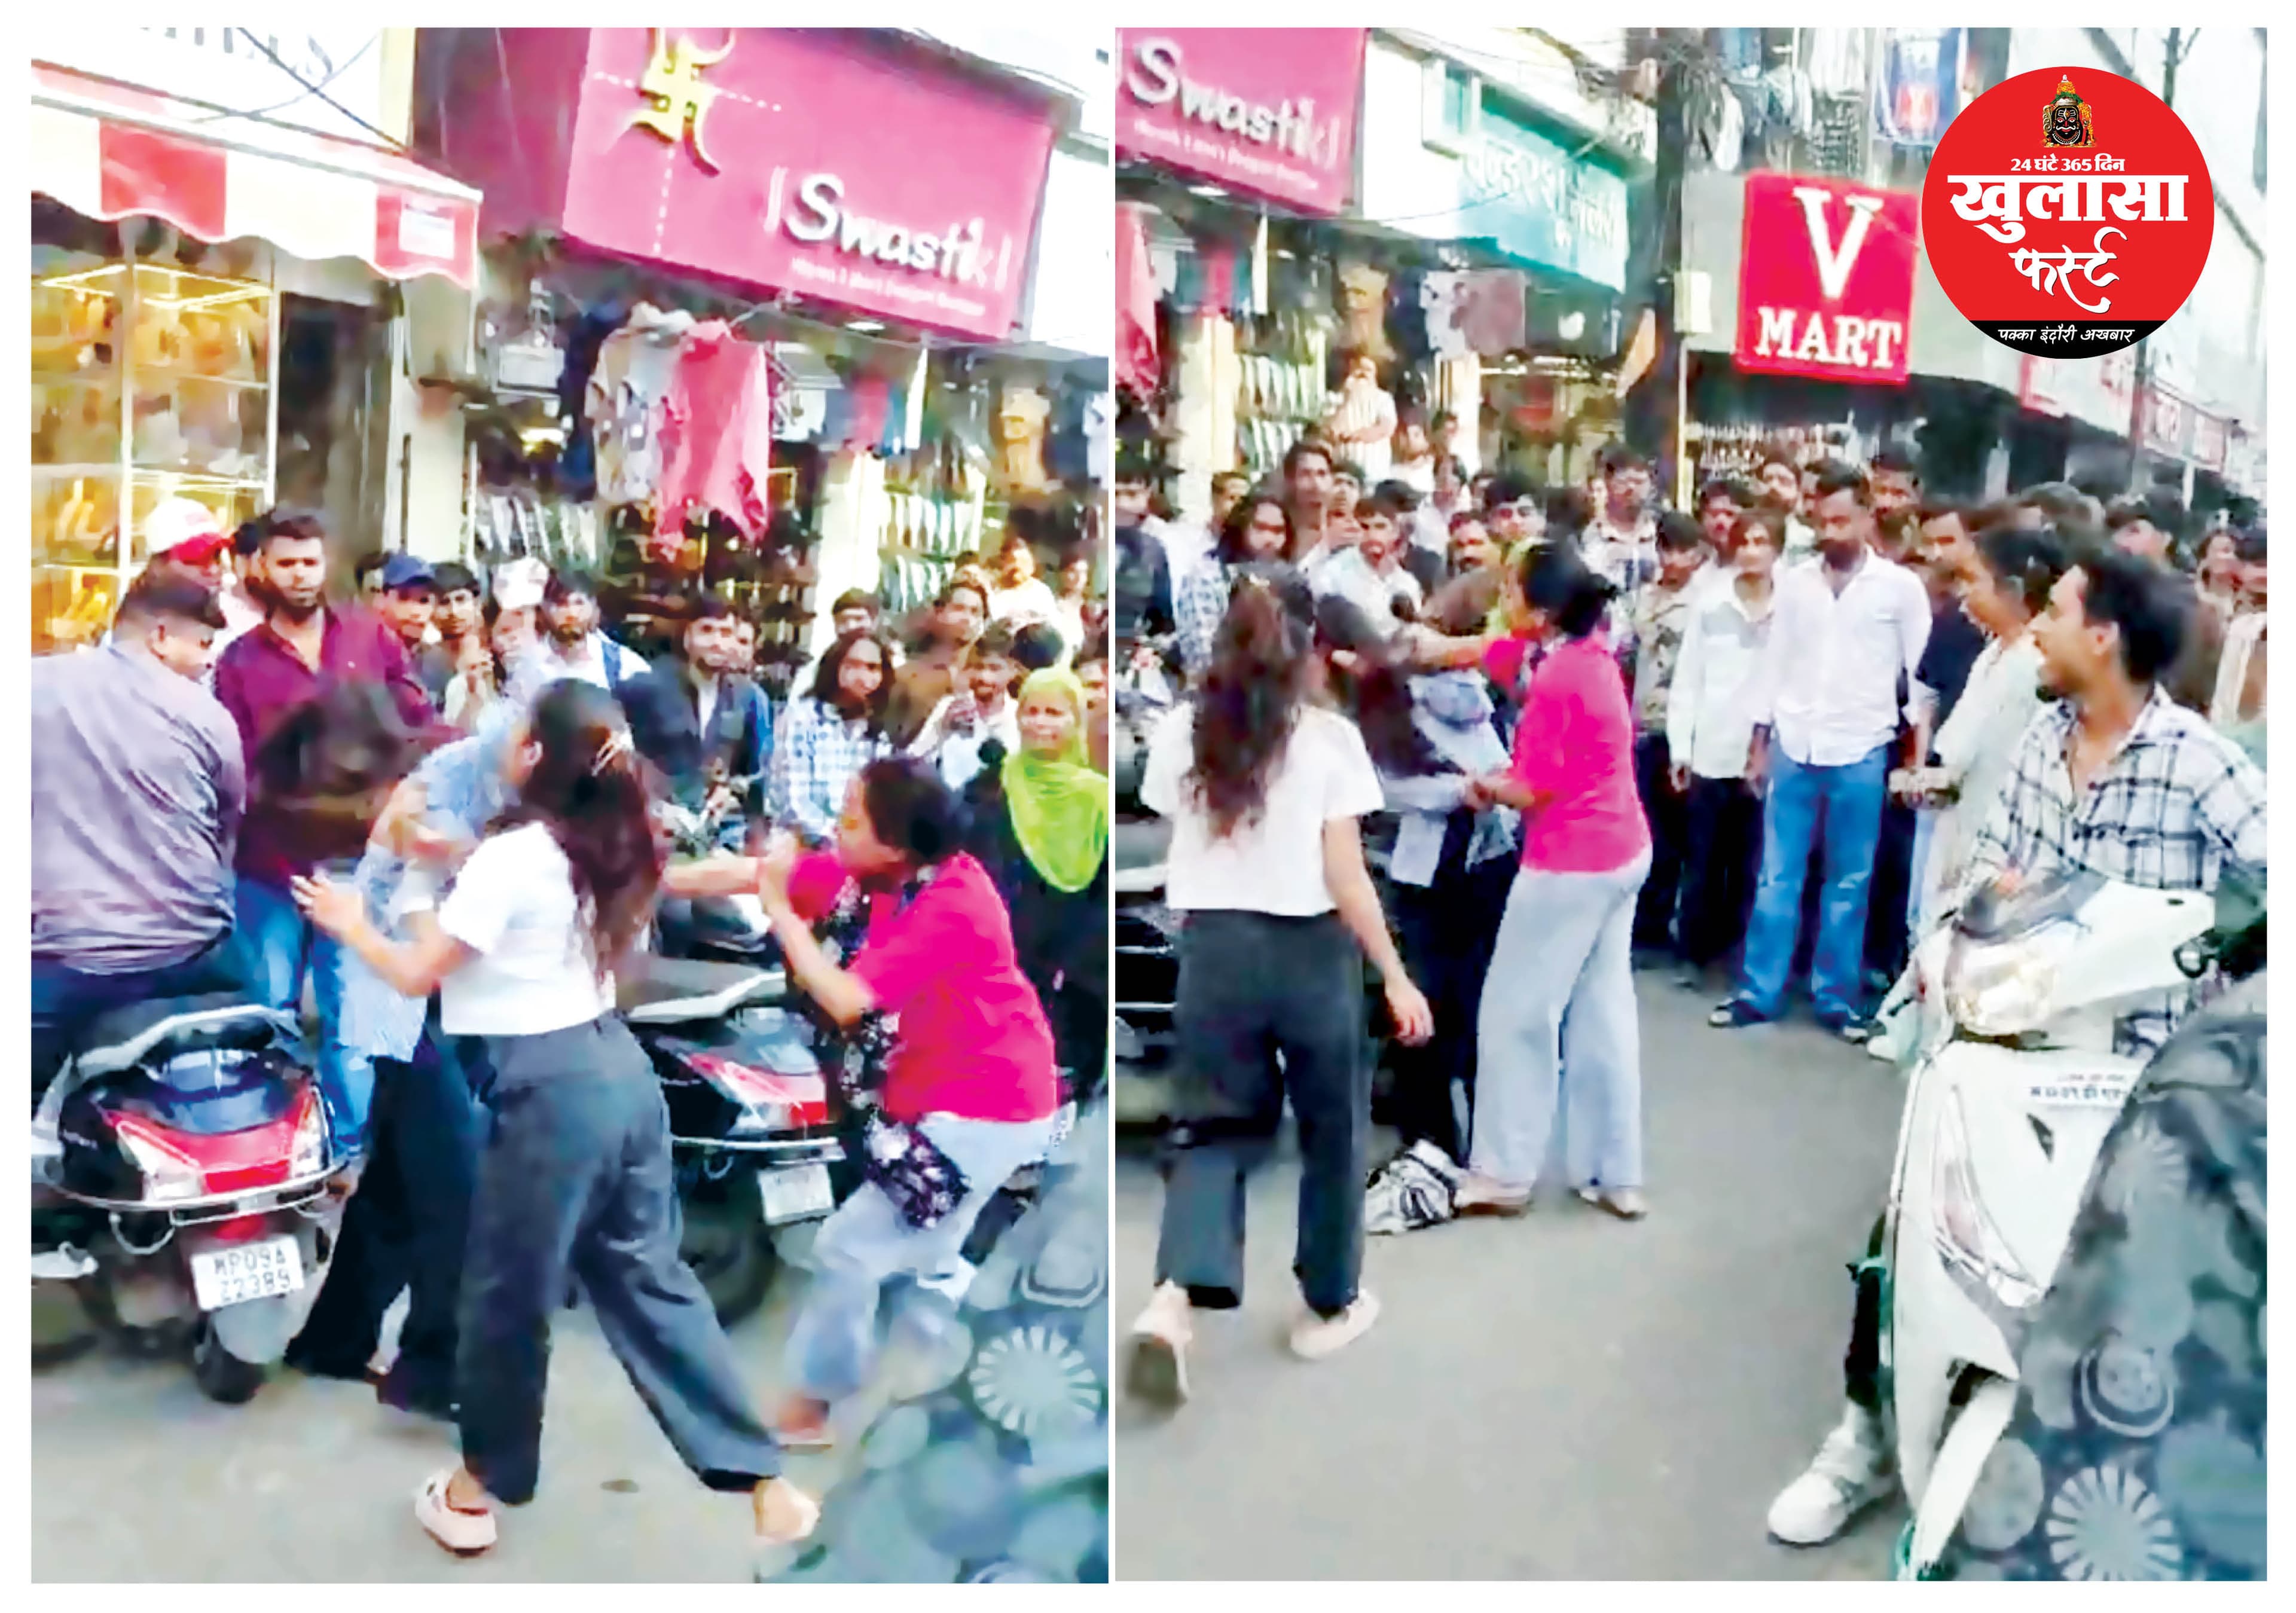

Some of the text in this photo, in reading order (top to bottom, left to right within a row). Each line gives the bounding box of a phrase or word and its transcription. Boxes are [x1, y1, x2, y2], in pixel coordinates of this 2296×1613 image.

[1127, 36, 1327, 166] Swastik
[784, 172, 994, 288] Swastik
[1792, 187, 1885, 300] V
[1754, 306, 1903, 369] MART
